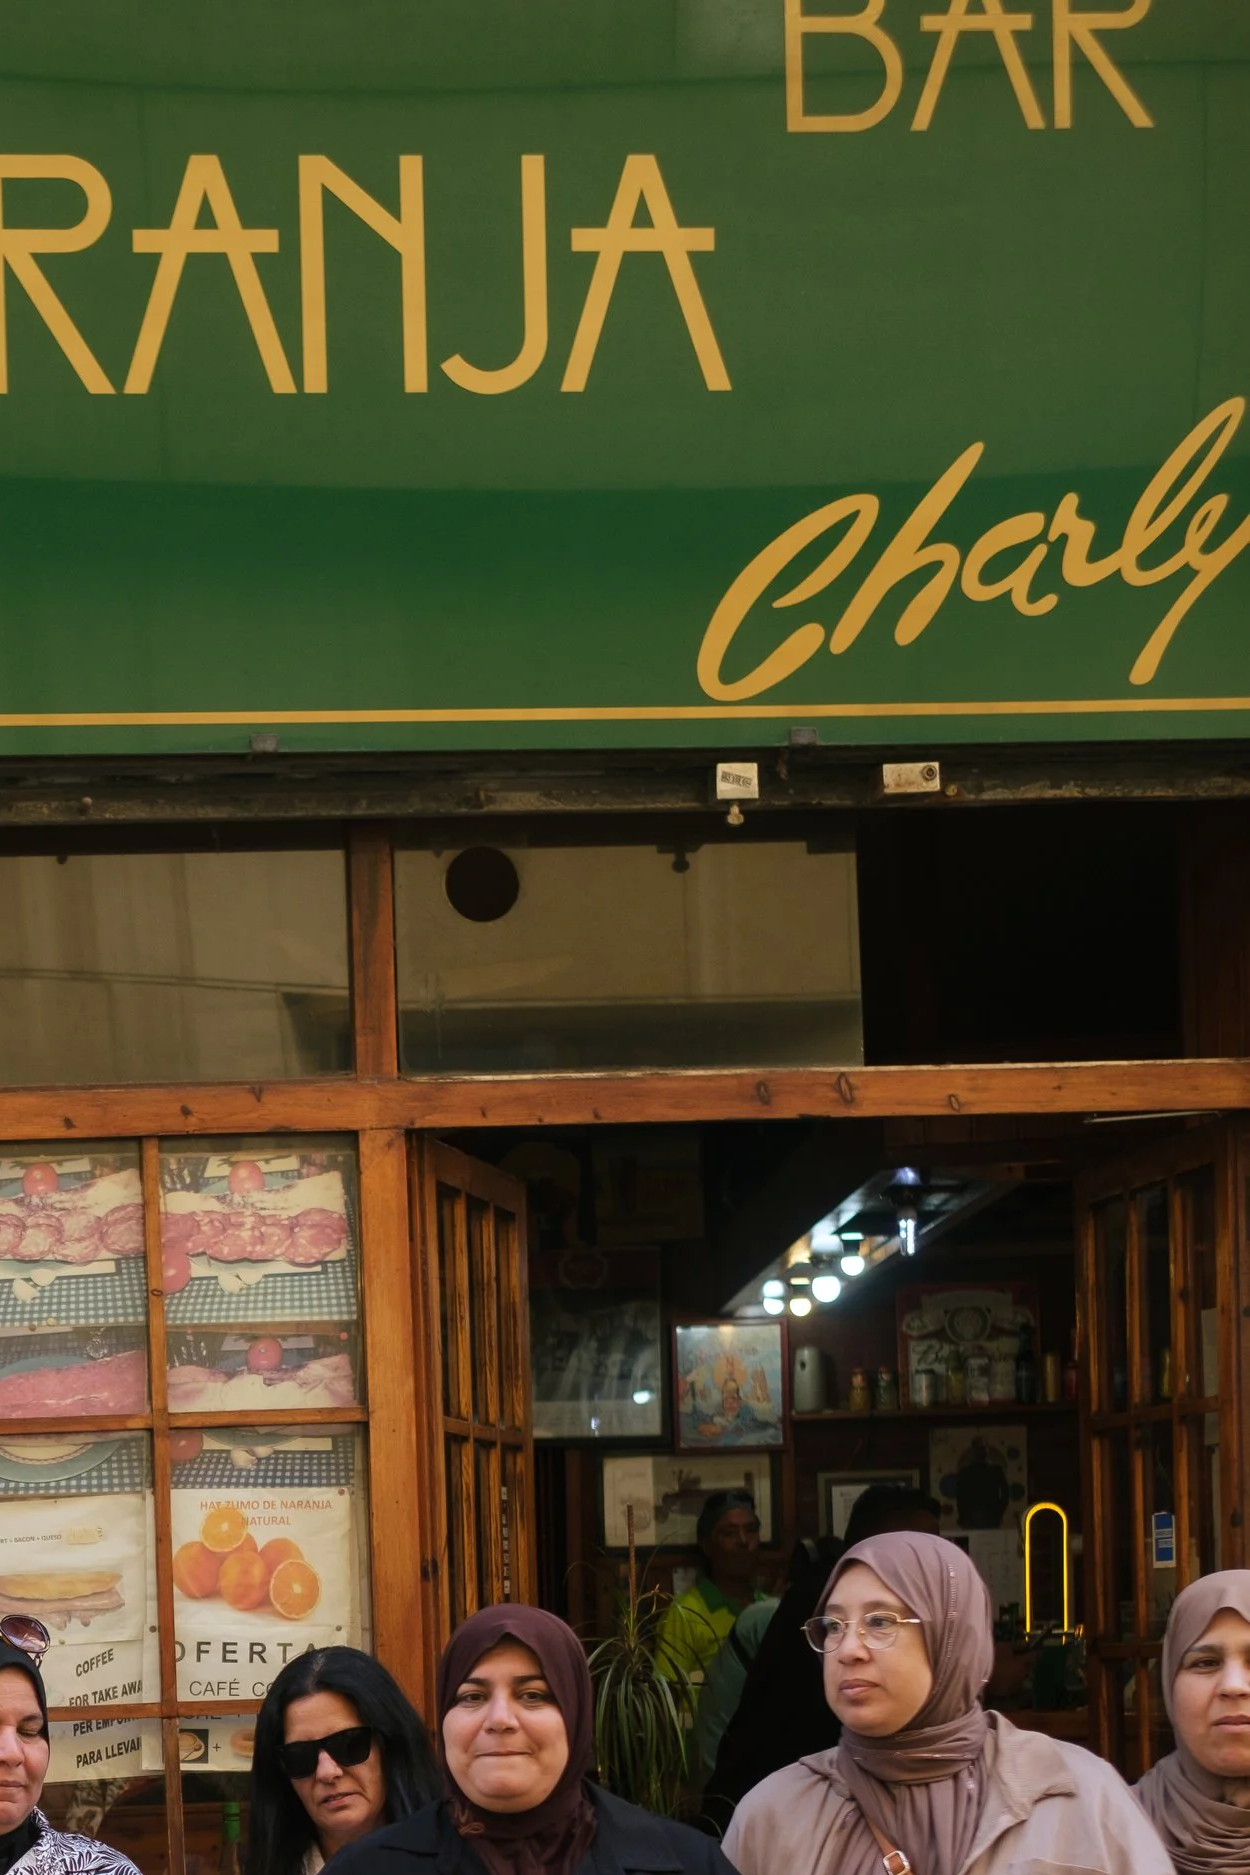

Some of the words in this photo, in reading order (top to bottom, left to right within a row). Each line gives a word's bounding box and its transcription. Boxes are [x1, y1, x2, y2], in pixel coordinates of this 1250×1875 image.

[784, 0, 1154, 132] BAR
[696, 396, 1250, 702] Charly
[200, 1500, 222, 1510] HAY
[225, 1500, 260, 1510] ZUMO
[263, 1500, 277, 1510] DE
[280, 1500, 332, 1510] NARANJA
[241, 1516, 292, 1526] NATURAL
[14, 1536, 35, 1544] BACON
[41, 1534, 62, 1542] QUESO
[75, 1648, 114, 1677] COFFEE
[68, 1693, 90, 1706] FOR
[91, 1686, 119, 1703] TAKE
[121, 1679, 143, 1697] AWA
[189, 1678, 240, 1697] CAFÉ
[73, 1719, 93, 1736] PER
[76, 1749, 103, 1768] PARA
